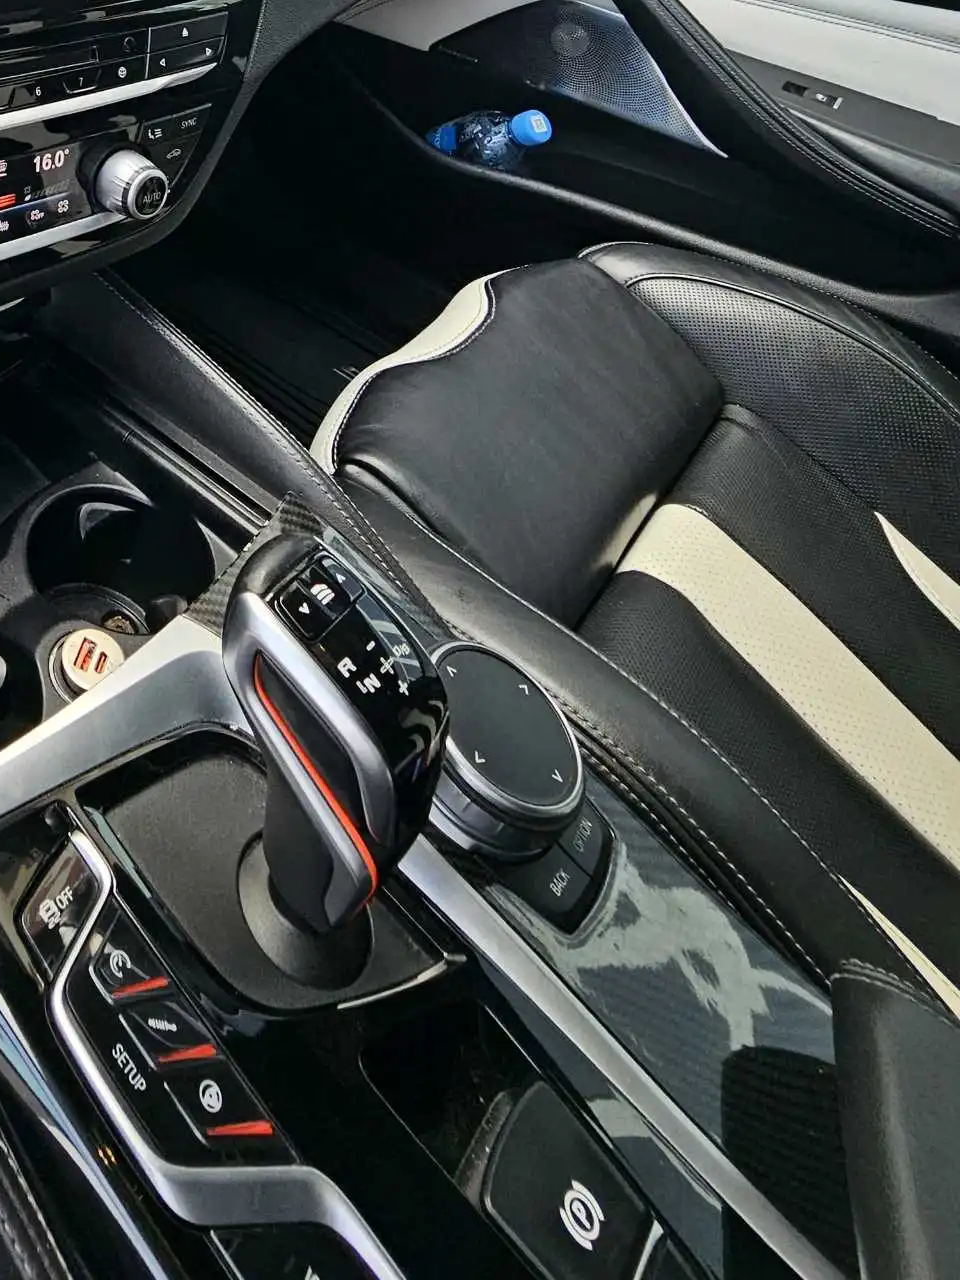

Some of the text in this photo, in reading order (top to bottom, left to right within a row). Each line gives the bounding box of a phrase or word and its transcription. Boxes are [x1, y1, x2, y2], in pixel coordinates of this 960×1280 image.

[35, 86, 42, 97] 6
[78, 77, 84, 88] 7
[181, 117, 197, 130] SYNC
[32, 148, 70, 173] 16.0°
[142, 191, 162, 204] AUTO
[337, 656, 357, 678] R
[363, 673, 381, 694] N
[573, 816, 593, 853] OPTION
[549, 867, 571, 897] BACK
[56, 886, 74, 911] OFF
[111, 1043, 147, 1092] SETUP
